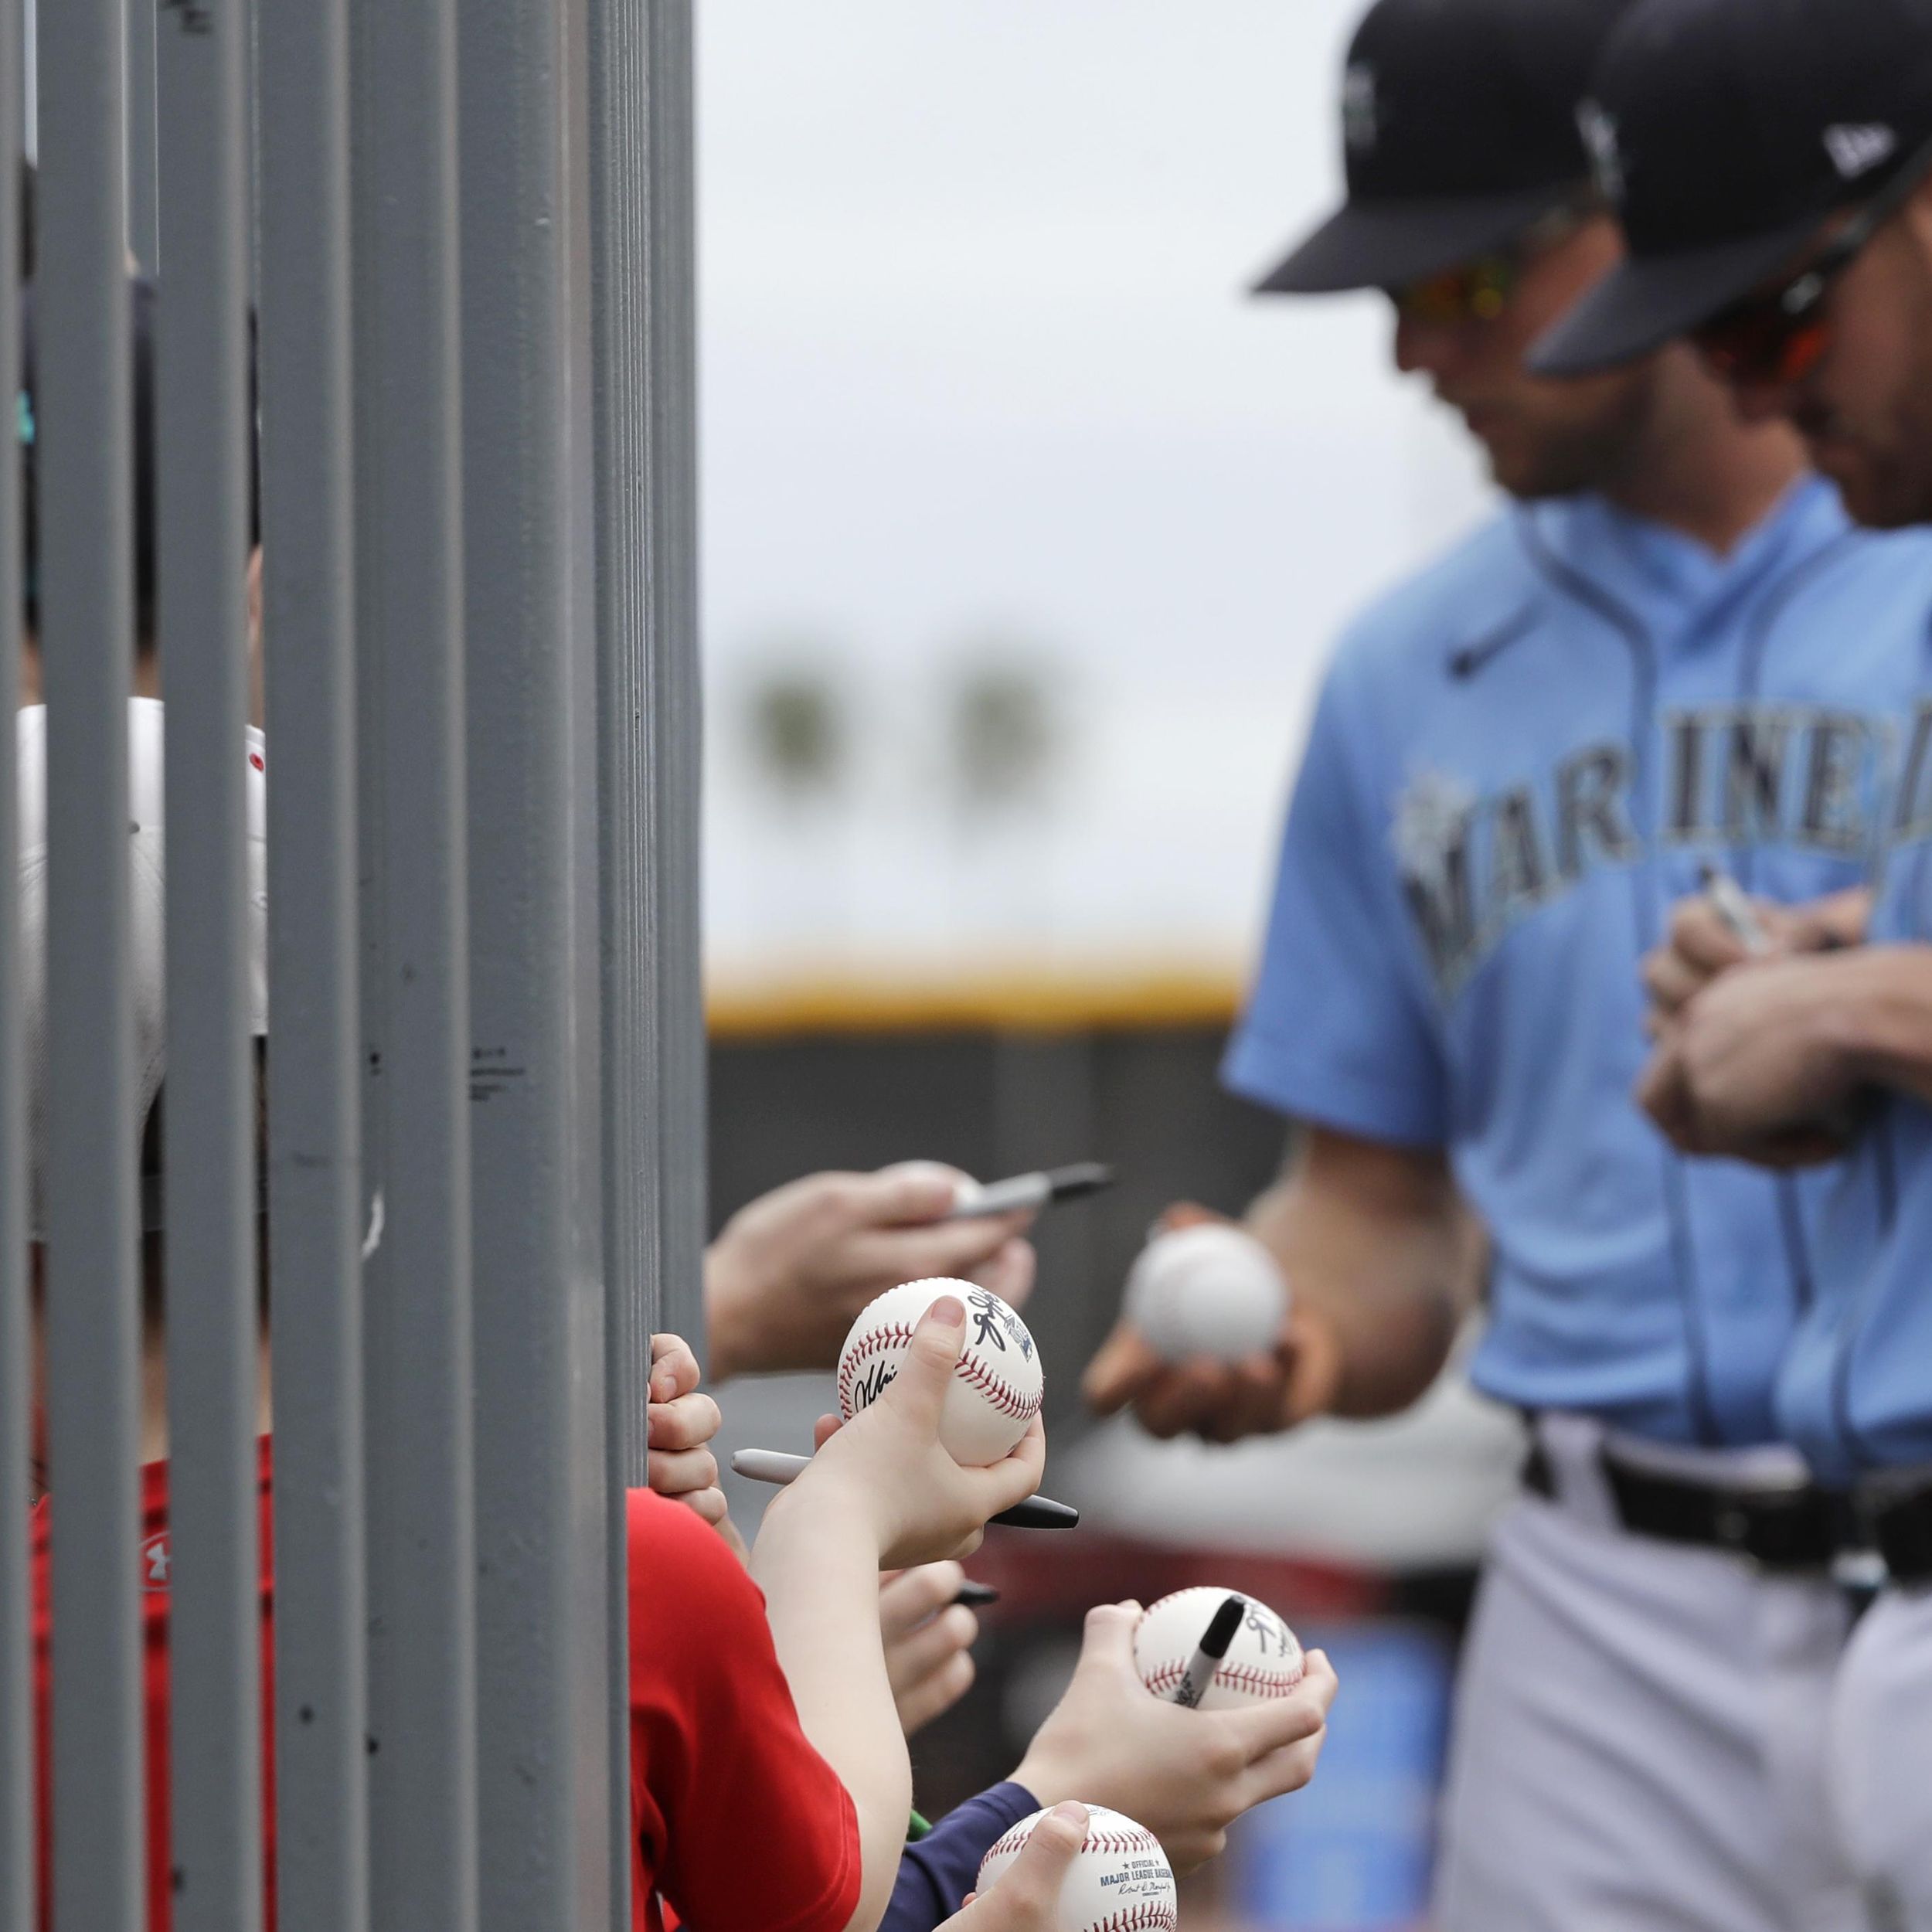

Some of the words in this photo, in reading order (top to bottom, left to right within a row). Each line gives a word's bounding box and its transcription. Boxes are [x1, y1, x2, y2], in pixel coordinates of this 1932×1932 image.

[1389, 698, 1932, 997] MARINE
[1131, 1859, 1155, 1869] OFFICIAL
[1100, 1872, 1130, 1886] MAJOR
[1131, 1869, 1155, 1880] LEAGUE
